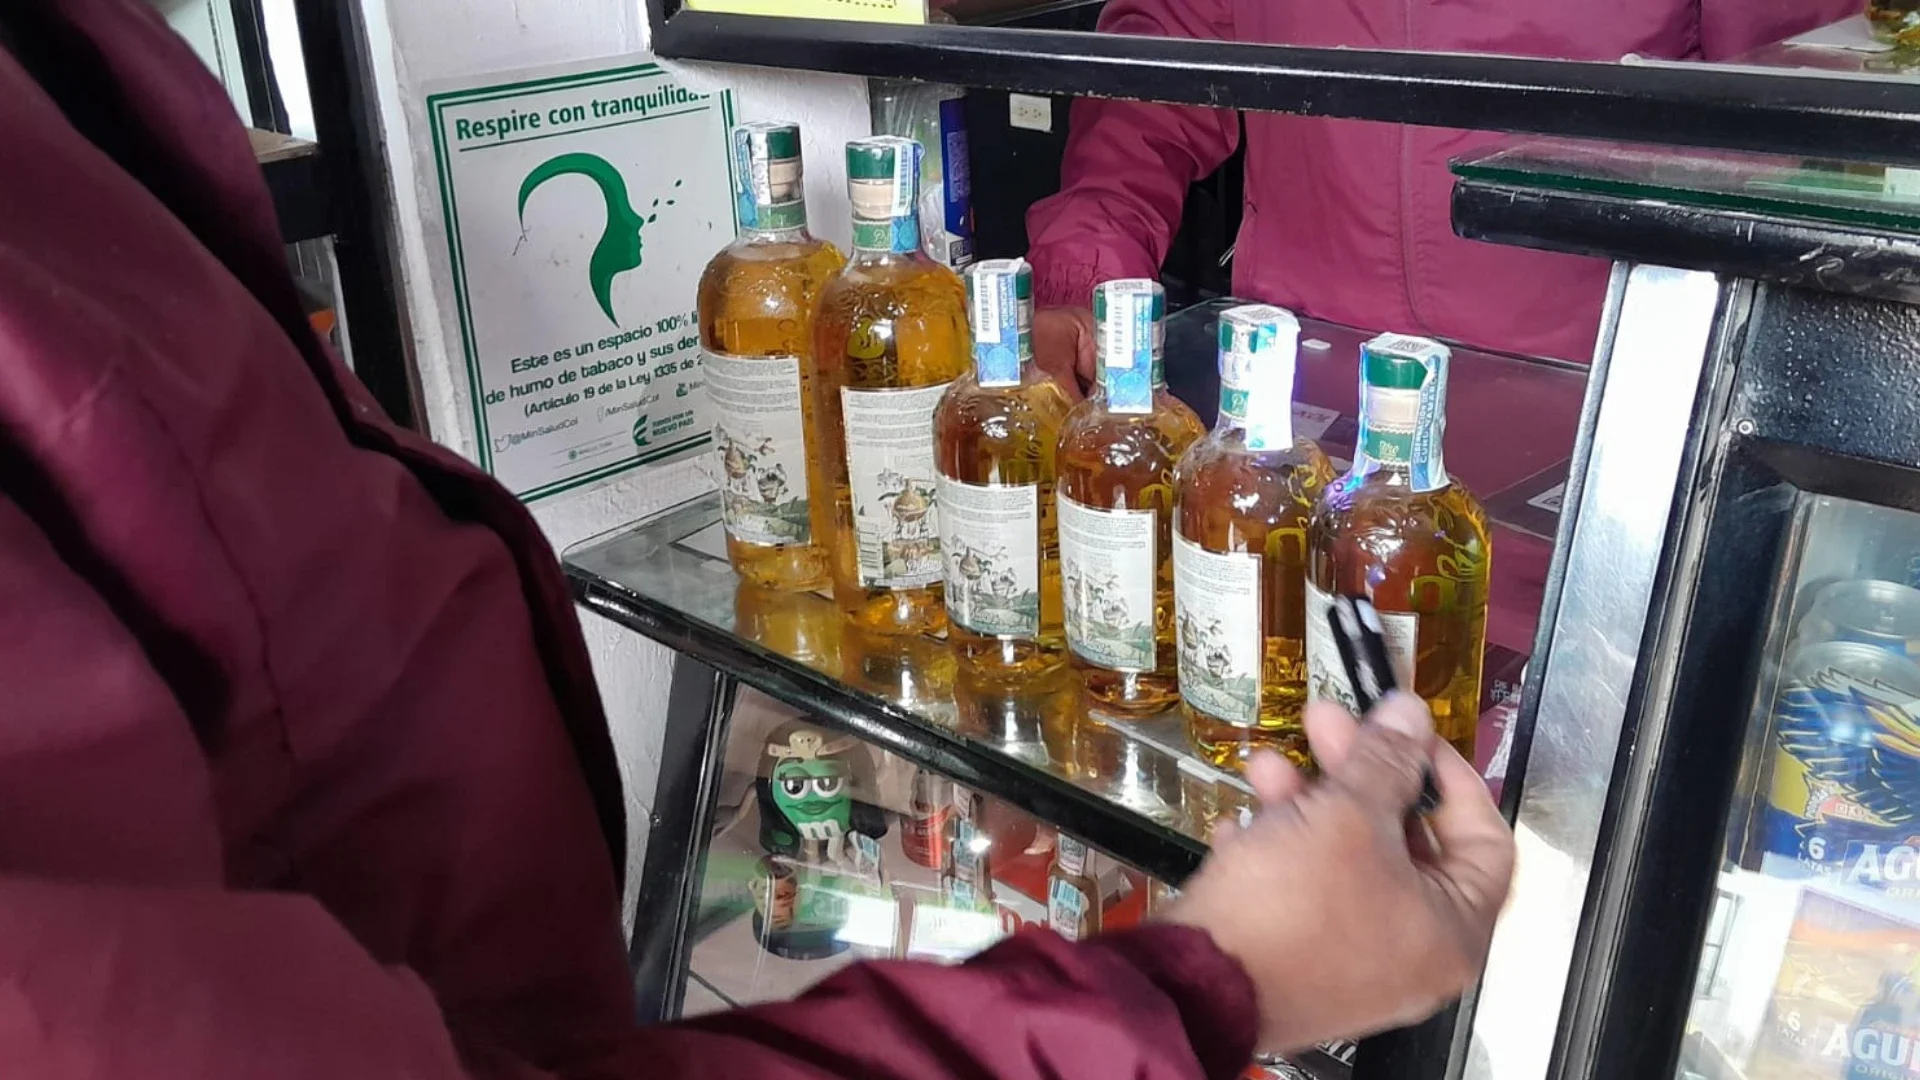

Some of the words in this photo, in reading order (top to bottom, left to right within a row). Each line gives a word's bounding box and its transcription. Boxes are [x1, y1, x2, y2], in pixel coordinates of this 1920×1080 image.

[456, 109, 541, 140] Respire
[548, 105, 585, 125] con
[511, 354, 549, 373] Este
[553, 348, 571, 362] es
[575, 342, 594, 356] un
[598, 325, 653, 350] espacio
[657, 312, 689, 333] 100%
[486, 390, 505, 405] de
[509, 377, 554, 398] humo
[558, 370, 577, 384] de
[581, 355, 633, 378] tabaco
[637, 351, 646, 366] y
[650, 343, 674, 358] sus
[584, 386, 595, 399] 19
[598, 383, 613, 395] de
[616, 378, 626, 389] la
[629, 372, 651, 385] Ley
[654, 362, 677, 378] 1335
[681, 358, 694, 370] de
[1809, 837, 1826, 860] 6
